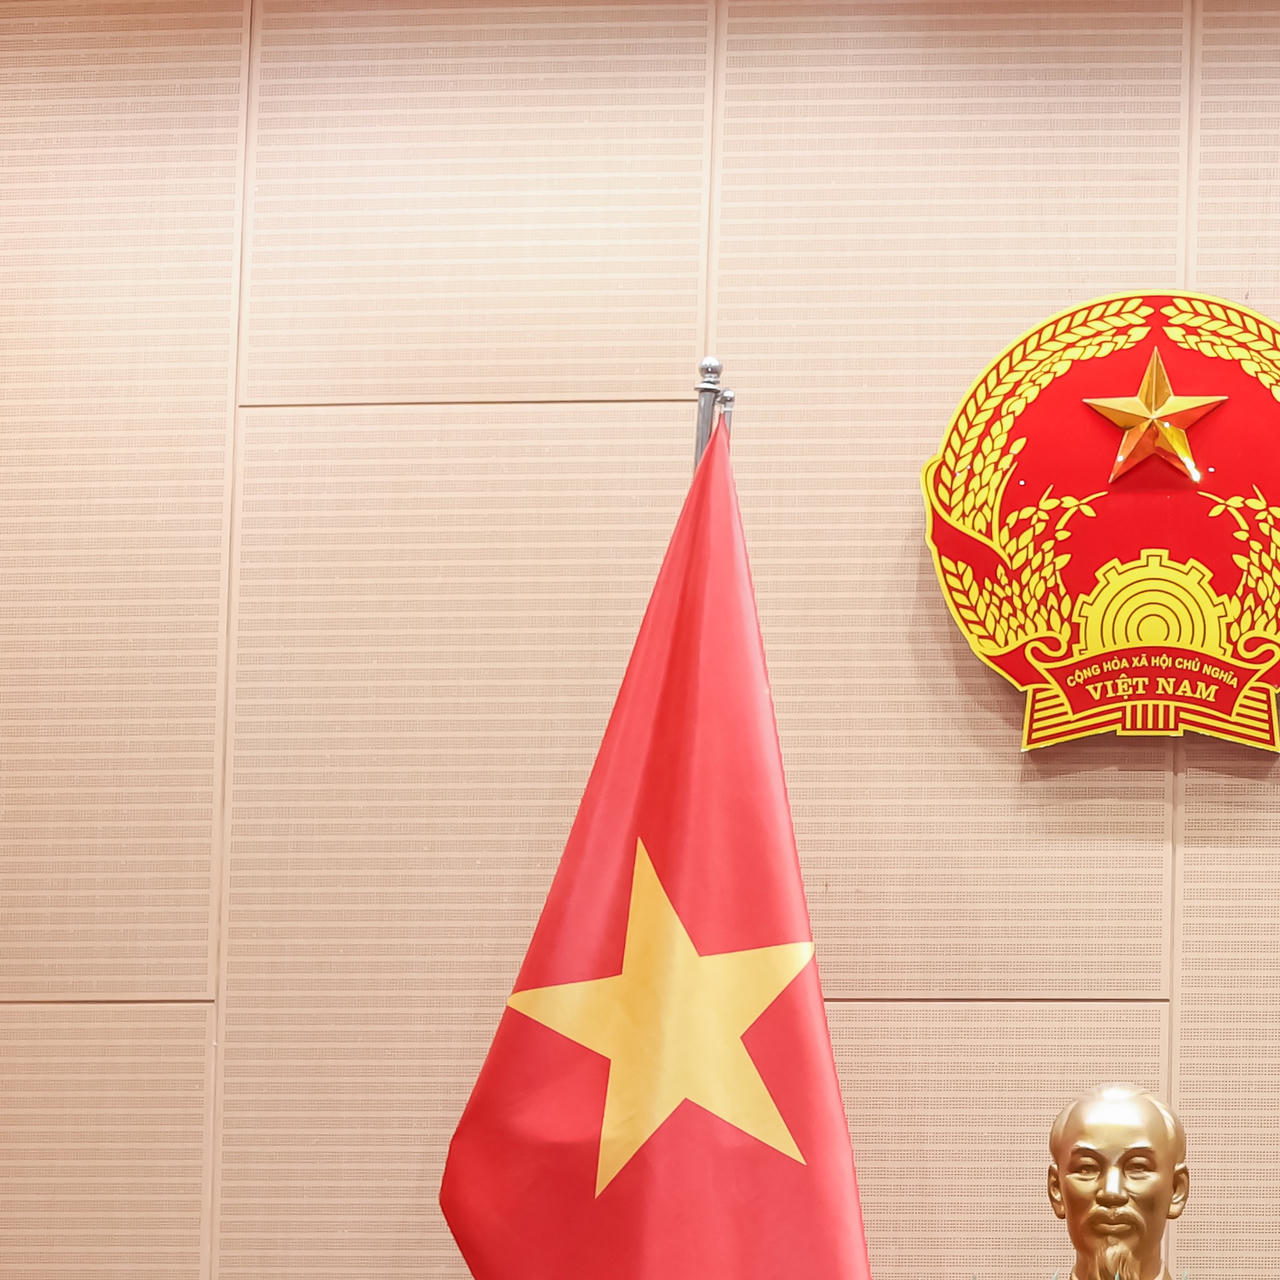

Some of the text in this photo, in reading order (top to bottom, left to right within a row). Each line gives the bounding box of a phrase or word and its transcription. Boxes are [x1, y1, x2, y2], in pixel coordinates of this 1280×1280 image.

[1066, 653, 1239, 689] CỘNG HÒA XÃ HỘI CHỦ NGHĨA
[1085, 673, 1219, 703] VIỆT NAM
